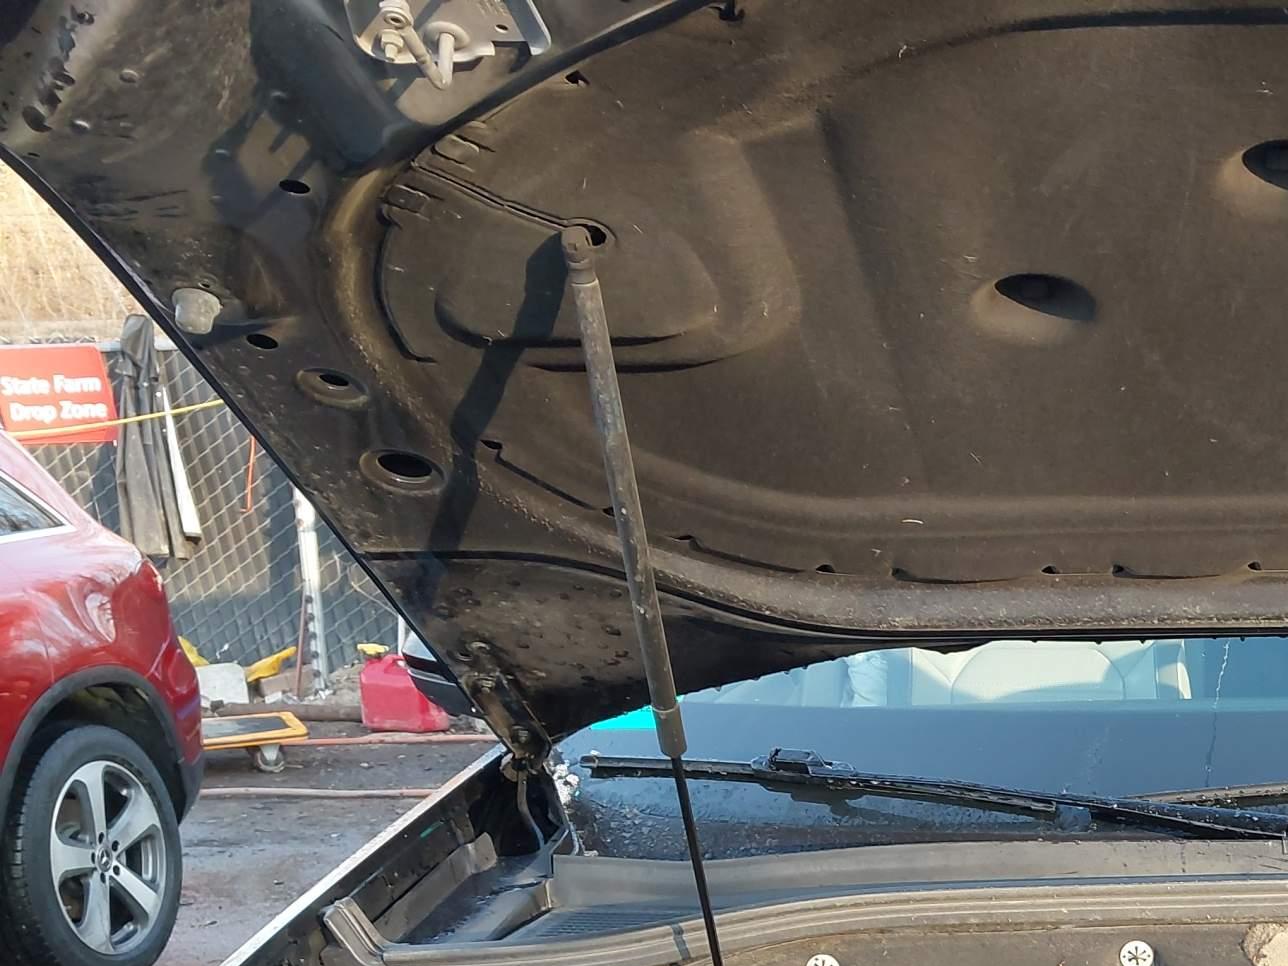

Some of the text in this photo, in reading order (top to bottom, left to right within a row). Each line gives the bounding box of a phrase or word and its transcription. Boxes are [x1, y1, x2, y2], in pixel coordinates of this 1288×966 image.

[1, 375, 101, 396] State Farm
[10, 401, 107, 424] Drop Zone
